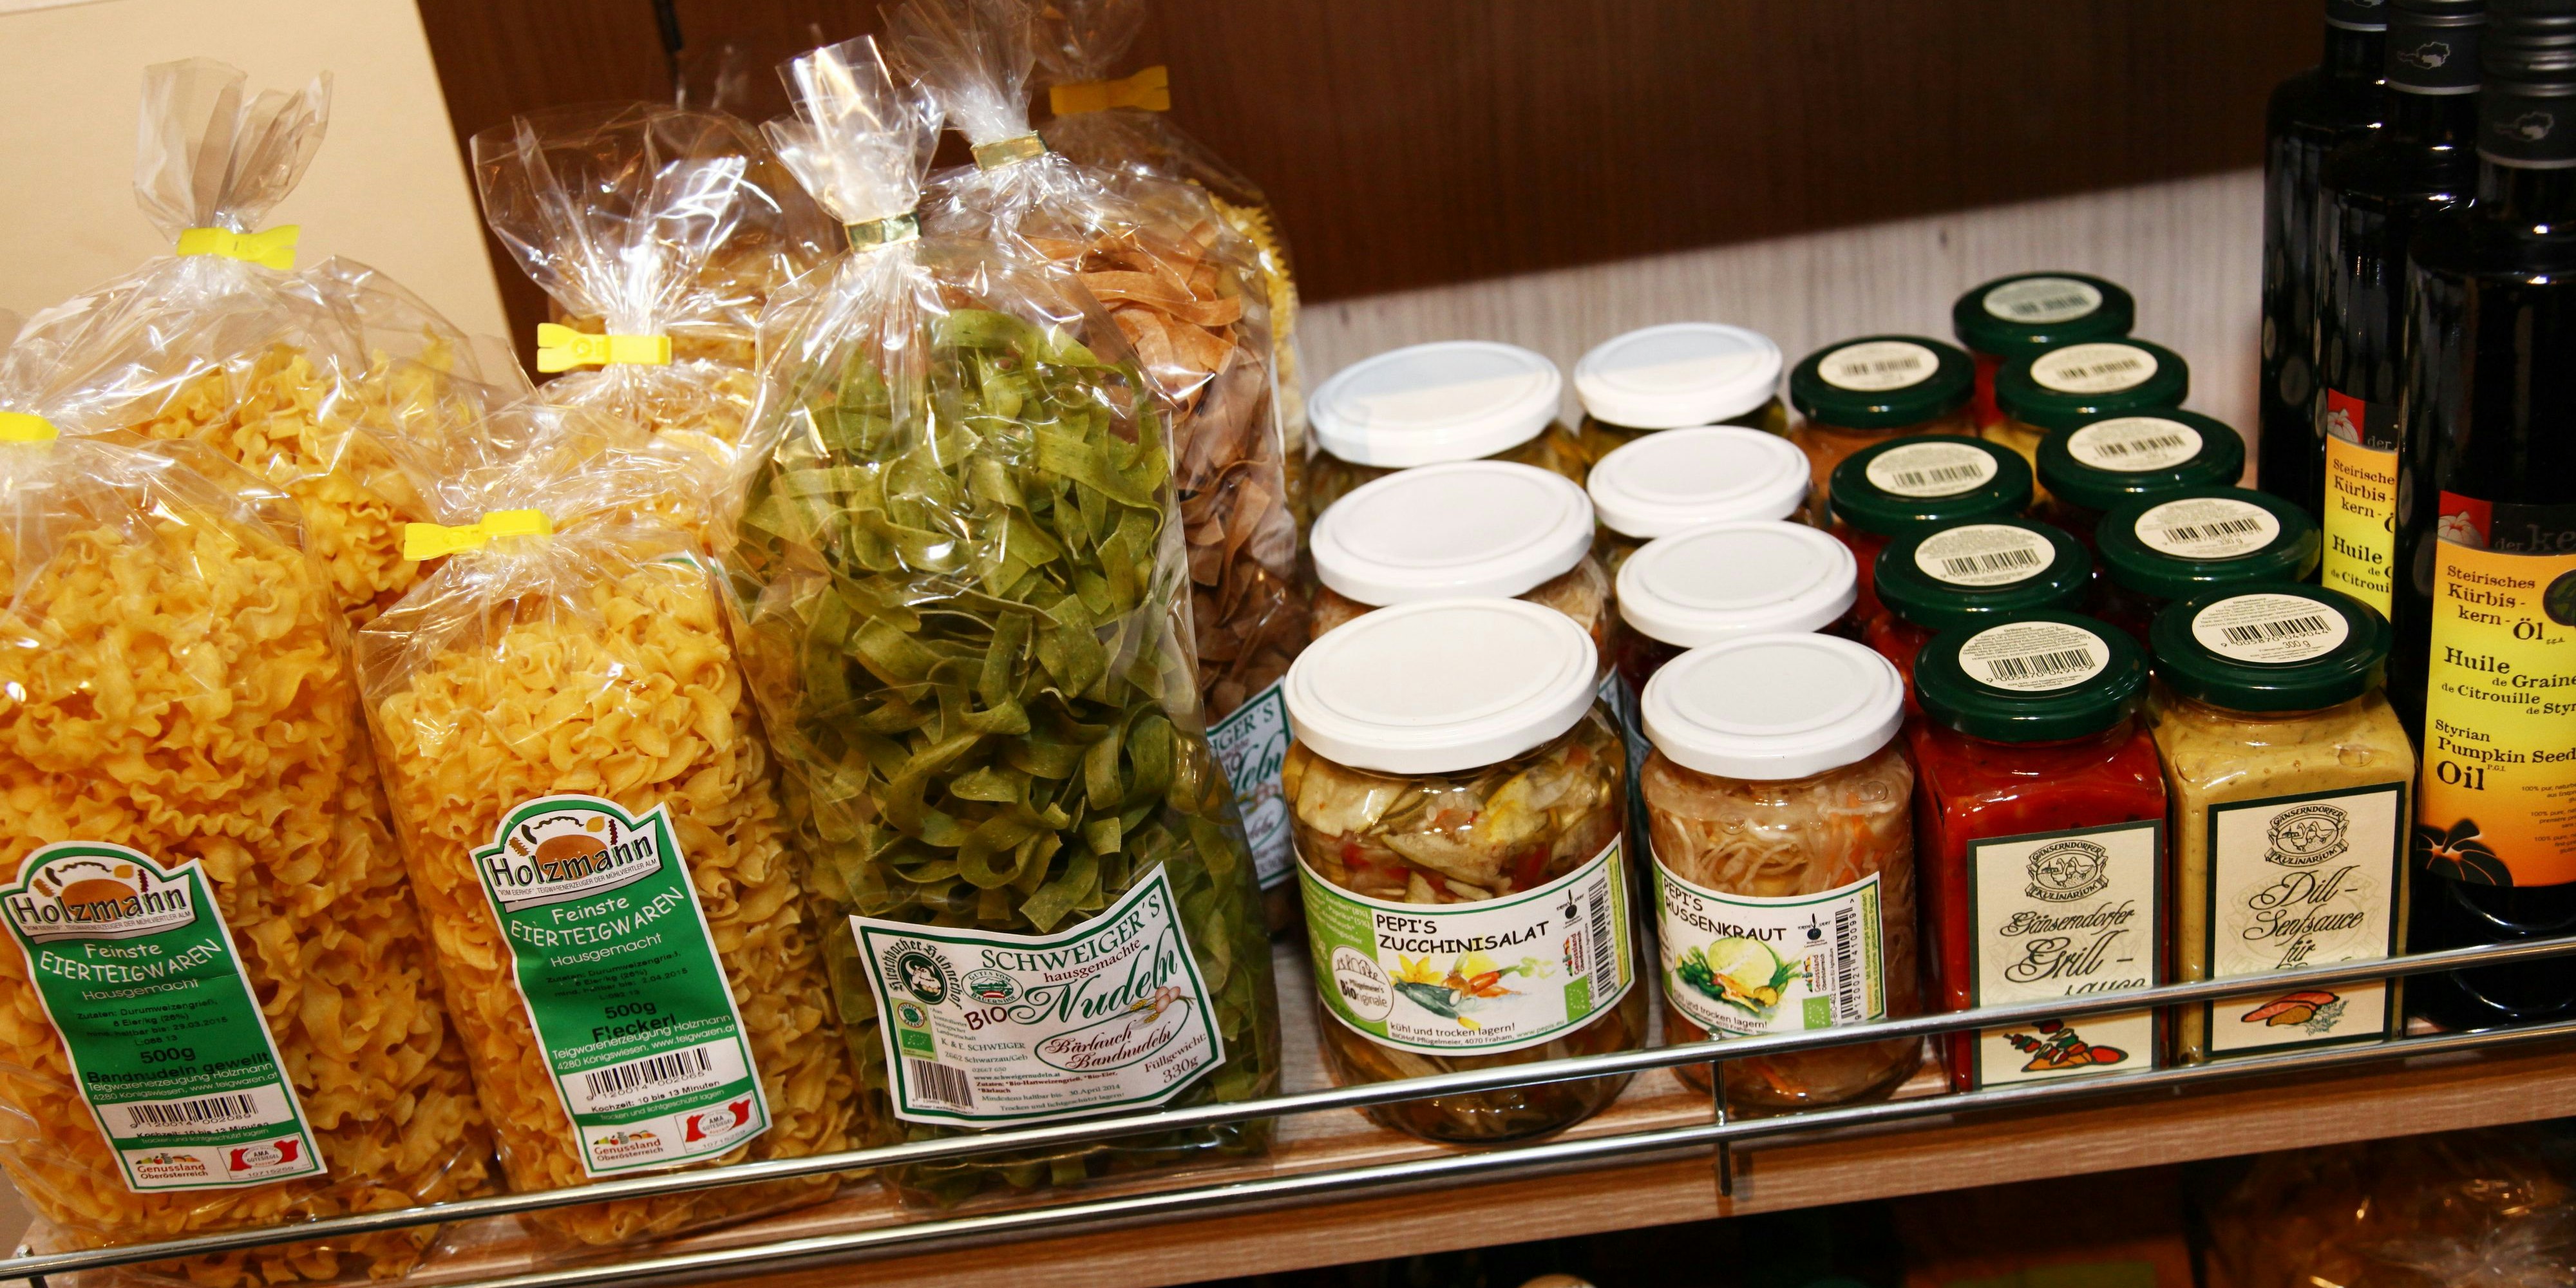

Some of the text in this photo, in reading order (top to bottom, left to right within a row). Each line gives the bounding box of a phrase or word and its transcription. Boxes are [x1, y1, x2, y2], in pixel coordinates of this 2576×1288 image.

[2367, 436, 2392, 450] der
[2333, 458, 2395, 485] Steirische
[2332, 534, 2383, 565] Huile
[2495, 538, 2523, 551] der
[2331, 569, 2390, 593] de Citroui
[2368, 567, 2380, 576] de
[2447, 565, 2535, 589] Steirisches
[2513, 617, 2543, 640] Öl
[2302, 639, 2311, 648] g
[2443, 645, 2510, 674] Huile
[2000, 672, 2044, 682] 005870
[2049, 665, 2093, 676] 049129
[2492, 677, 2507, 687] de
[2441, 683, 2541, 705] de Citrouille
[2526, 706, 2540, 715] de
[2435, 719, 2491, 743] Styrian
[2438, 736, 2576, 763] Pumpkin Seed
[2437, 760, 2485, 791] Oil
[2273, 806, 2344, 828] GÄNSERNDORFER
[487, 836, 653, 886] Holzmann
[2032, 841, 2103, 863] GÄNSERNDORFER
[2275, 848, 2338, 866] KULINARIUM
[538, 858, 657, 893] TEIGWARENERZEUGER DER MÜHLVIERTLER ALM
[2249, 864, 2360, 911] Dill
[1663, 878, 1703, 912] PEPI'S
[2036, 882, 2099, 902] KULINARIUM
[9, 889, 187, 923] Holzmann
[511, 886, 685, 947] EIERTEIGWAREN
[552, 897, 629, 924] Feinste
[2000, 900, 2135, 936] Gänserndorfer
[137, 913, 177, 925] MÜHLVIERTLER
[1376, 914, 1437, 934] PEPI'S
[1665, 896, 1786, 942] RUSSENKRAUT
[2242, 903, 2364, 947] Senfsauce
[1379, 921, 1549, 954] ZUCCHINISALAT
[1848, 913, 1858, 954] 410099
[40, 938, 222, 983] EIERTEIGWAREN
[84, 943, 162, 959] Feinste
[551, 933, 663, 967] Hausgemacht
[1045, 939, 1141, 983] hausgemachte
[1570, 933, 1580, 975] Genussland
[2004, 929, 2129, 983] Grill
[2275, 938, 2316, 969] für
[969, 971, 1011, 982] GUTES VOM
[1008, 922, 1177, 1025] Nudeln
[1813, 954, 1821, 992] Genussland
[82, 978, 199, 1000] Hausgemacht
[971, 992, 1016, 1004] BAUERNHOF
[605, 1002, 657, 1019] 500g
[964, 1006, 1008, 1030] BIO
[1700, 1005, 1731, 1024] trocken
[1734, 1016, 1767, 1030] lagern!
[552, 1014, 731, 1061] Teigwarenerzeugung Holzmann
[592, 1012, 677, 1045] Fleckerl
[1045, 1019, 1137, 1056] Bärlauch
[1390, 1022, 1411, 1034] kühl
[1436, 1028, 1475, 1037] trocken
[1478, 1023, 1515, 1036] lagern!
[1417, 1037, 1463, 1045] Pflügelmeier,
[1485, 1034, 1513, 1043] Fraham,
[140, 1047, 196, 1064] 500g
[557, 1024, 735, 1070] 4280 Königswiesen, www.teigwaren.at
[968, 1042, 1025, 1052] SCHWEIGER
[1065, 1021, 1172, 1070] Bandnudeln
[1144, 1033, 1207, 1073] Füllgewicht:
[86, 1051, 270, 1084] Bandnudeln gewellt
[88, 1063, 273, 1093] Teigwarenerzeugung Holzmann
[974, 1072, 1060, 1081] www.schweigernudeln.at
[1162, 1055, 1198, 1084] 330g
[190, 1072, 278, 1092] www.teigwaren.at
[1081, 1086, 1101, 1097] April
[591, 1080, 720, 1113] Kochzeit: 10 bis 13 Minuten
[630, 1107, 645, 1116] und
[709, 1115, 724, 1124] AMA
[594, 1139, 661, 1155] Genussland
[597, 1146, 663, 1162] Oberösterreich
[137, 1164, 205, 1172] Genussland
[140, 1171, 208, 1179] Oberösterreich
